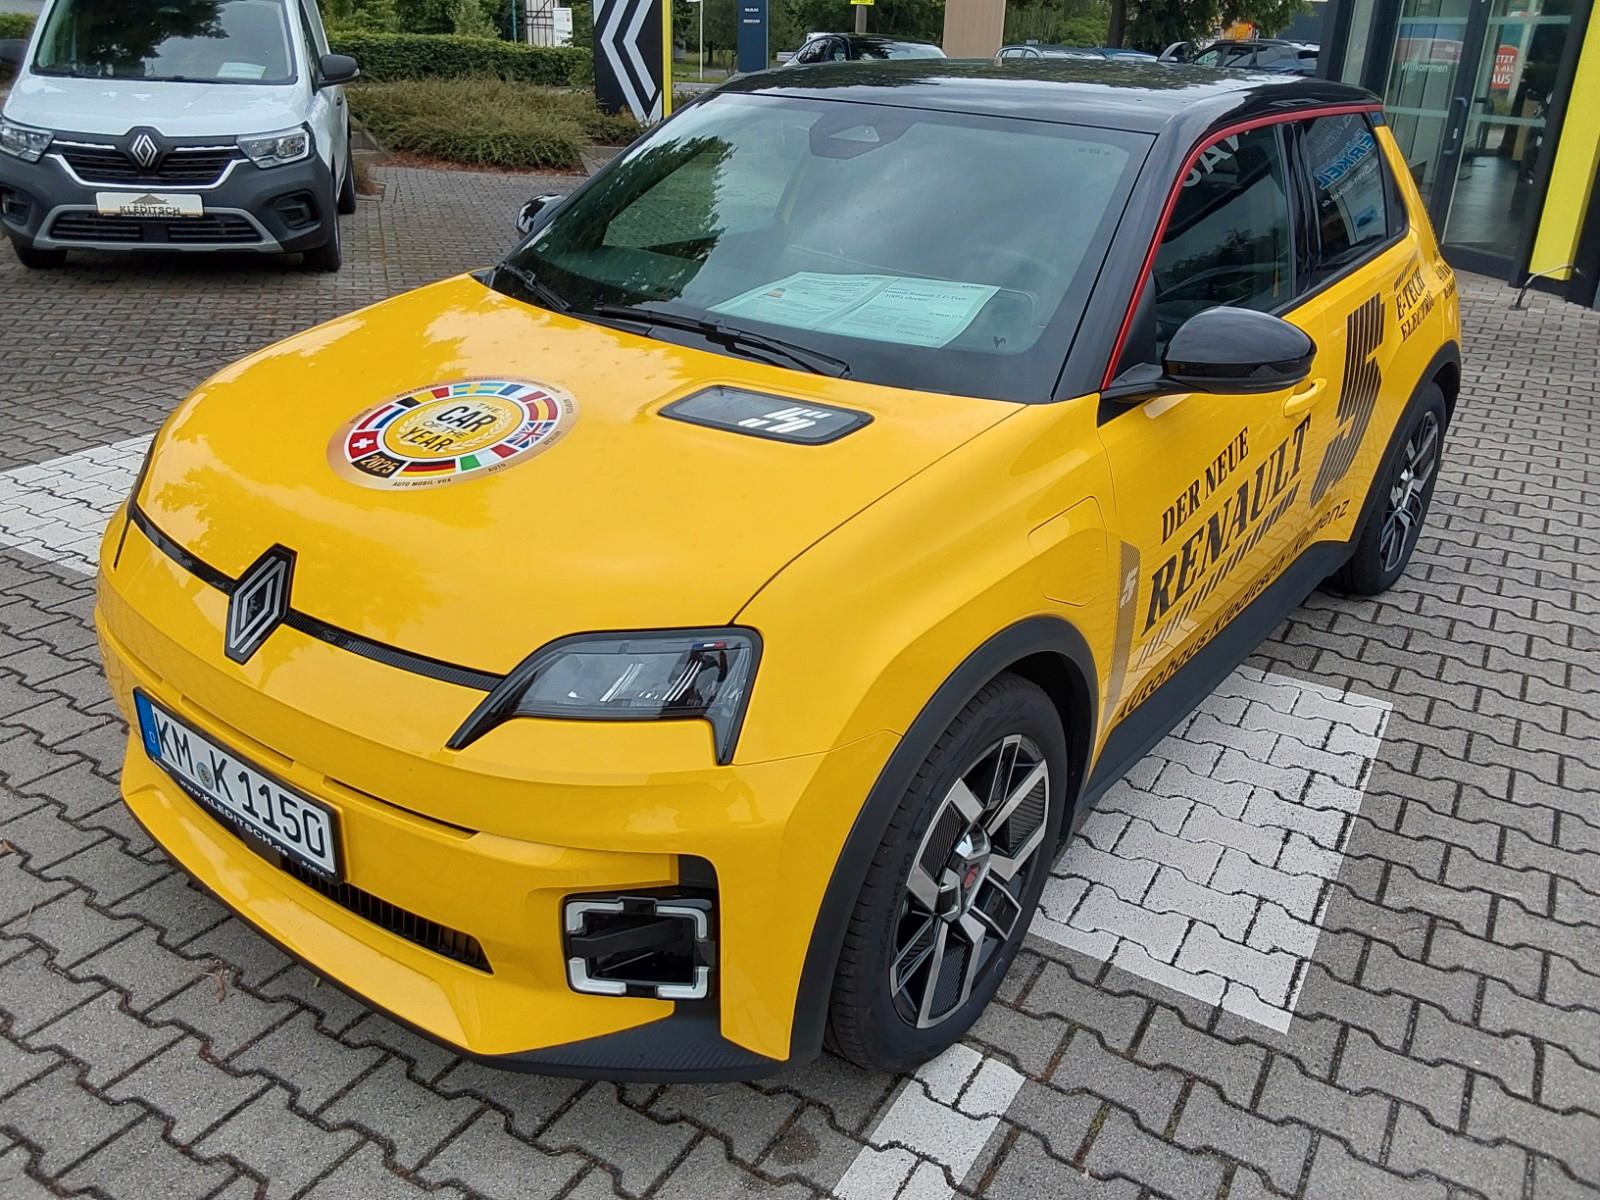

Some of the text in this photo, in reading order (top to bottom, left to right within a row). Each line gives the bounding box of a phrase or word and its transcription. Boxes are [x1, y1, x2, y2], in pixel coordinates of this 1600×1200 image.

[1400, 61, 1449, 73] Willkommen
[119, 205, 181, 215] KLEDITSCH
[1396, 266, 1426, 321] E-TECH
[436, 406, 498, 433] CAR
[479, 402, 503, 414] THE
[400, 426, 454, 452] YEAR
[422, 420, 469, 440] OF THE
[360, 454, 400, 475] 2025
[1161, 425, 1249, 546] DER NEUE
[1140, 413, 1312, 638] RENAULT
[1118, 629, 1210, 720] Autohaus
[154, 713, 326, 858] KM K 1150
